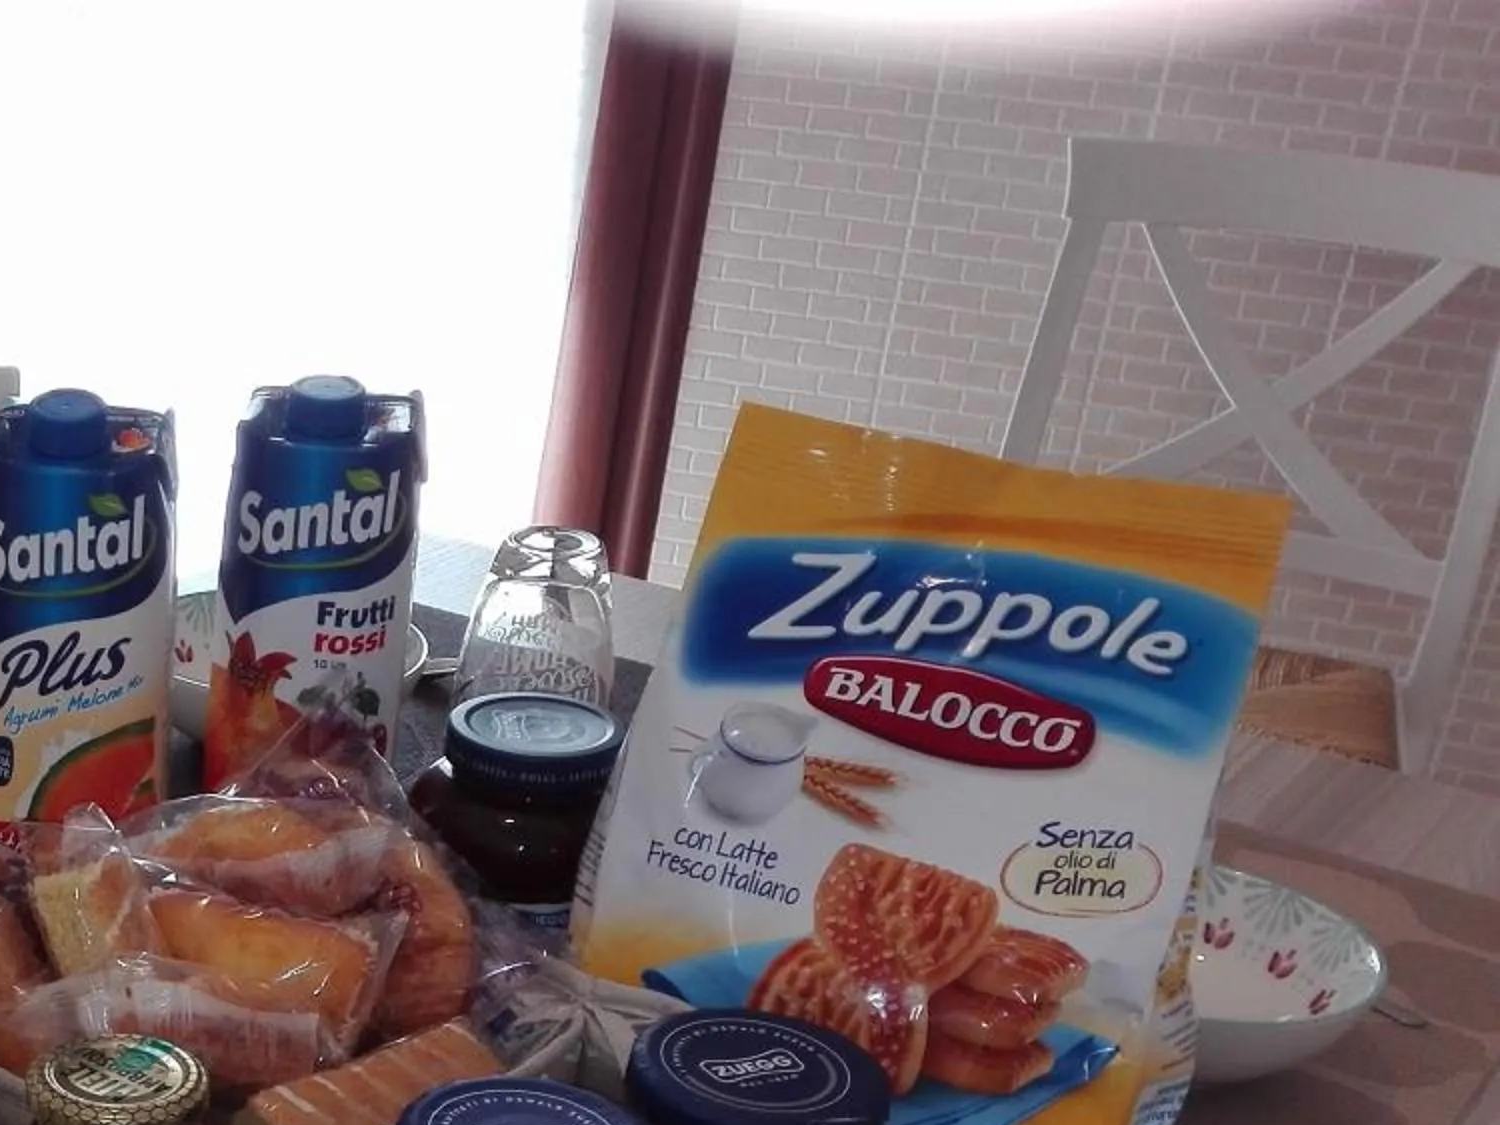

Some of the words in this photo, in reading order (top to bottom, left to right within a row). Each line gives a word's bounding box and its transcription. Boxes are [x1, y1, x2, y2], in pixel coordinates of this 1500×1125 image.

[316, 595, 396, 630] Frutti
[747, 552, 1189, 676] Zuppole
[313, 625, 388, 656] rossi
[3, 700, 60, 734] Agrumi
[67, 684, 124, 713] Melone
[824, 666, 1082, 754] BALOCCO
[673, 826, 713, 853] con
[715, 830, 779, 870] Latte
[1035, 820, 1135, 850] Senza
[646, 838, 717, 883] Fresco
[719, 861, 801, 905] Italiano
[1053, 850, 1093, 870] olio
[1095, 851, 1118, 870] di
[1033, 869, 1127, 899] Palma
[710, 1054, 793, 1078] ZUEGG
